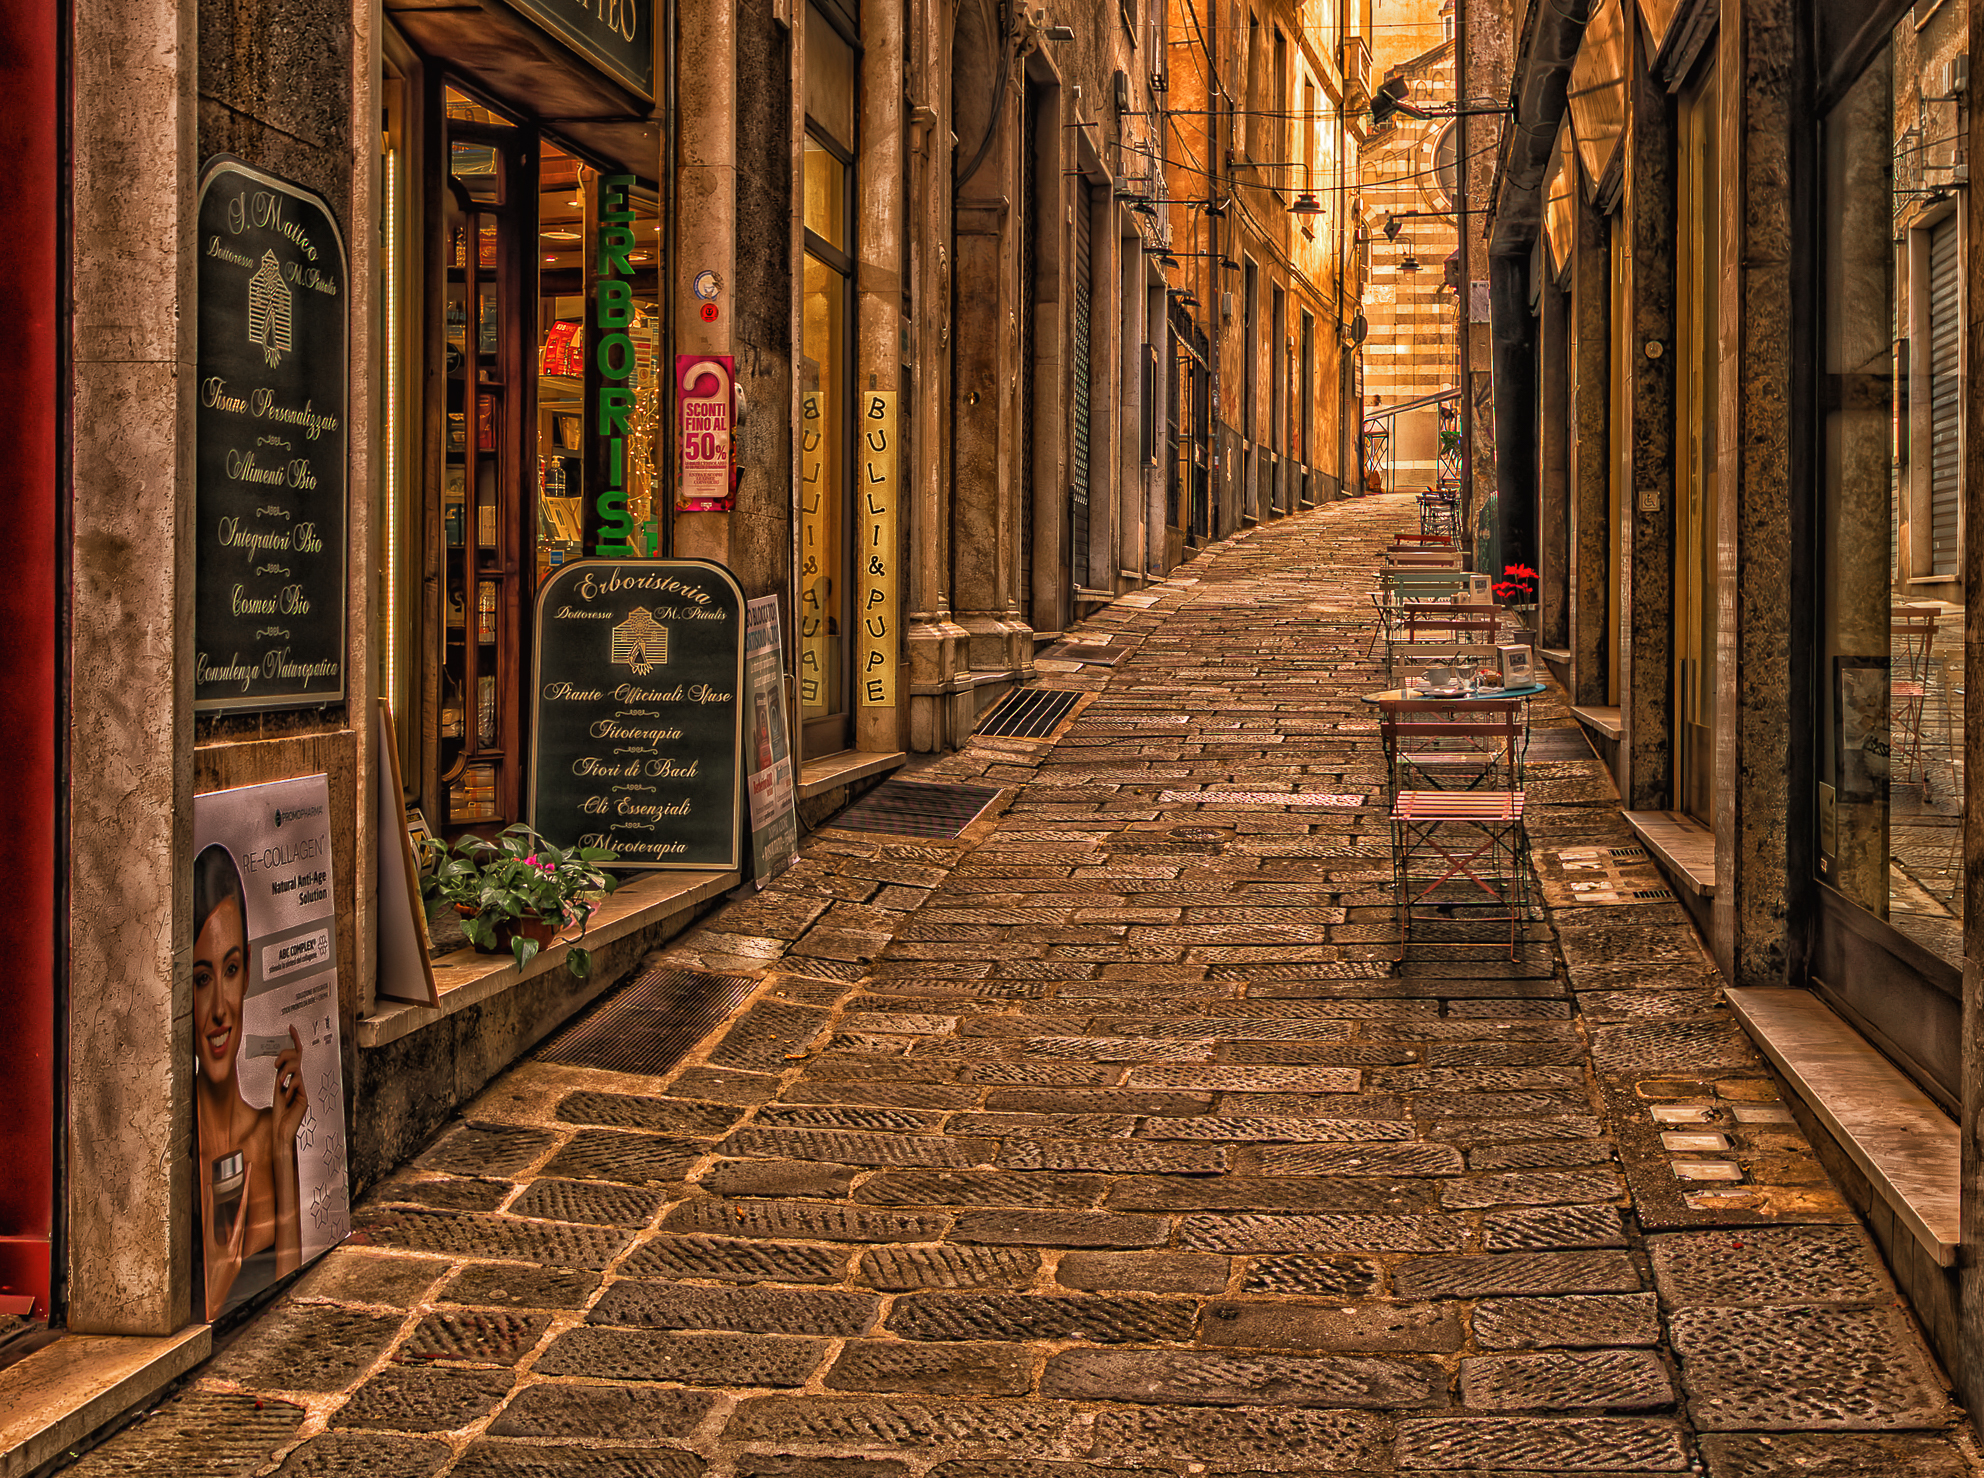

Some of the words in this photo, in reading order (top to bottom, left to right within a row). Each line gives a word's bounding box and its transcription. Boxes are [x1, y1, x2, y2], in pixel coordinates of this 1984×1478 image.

[596, 174, 637, 556] ERBORIS
[202, 376, 249, 414] Tisane
[251, 388, 340, 440] Personalizzate
[686, 402, 726, 417] SCONTI
[685, 417, 711, 431] FINO
[713, 417, 727, 431] AL
[685, 432, 727, 460] 50%
[226, 449, 285, 486] Alimenti
[287, 458, 318, 490] Bio
[218, 516, 291, 562] Integratori
[293, 521, 323, 553] Bio
[574, 566, 712, 605] Erboristeria
[232, 583, 278, 617] Cosmesi
[279, 584, 311, 615] Bio
[553, 605, 614, 620] Dottoressa
[197, 652, 261, 692] Consulenza
[263, 646, 339, 689] Naturopatica
[543, 681, 604, 701] Piante
[607, 683, 684, 705] Officinali
[687, 683, 733, 705] Sfuse
[589, 719, 684, 747] Fitoterapia
[572, 757, 621, 777] Fiori
[624, 759, 641, 777] di
[644, 758, 699, 778] Bach
[577, 795, 609, 814] Oli
[613, 796, 691, 822] Essenziali
[578, 833, 688, 860] Micoterapia
[272, 875, 297, 896] Natural
[298, 871, 327, 888] Anti-Age
[299, 888, 328, 906] Solution
